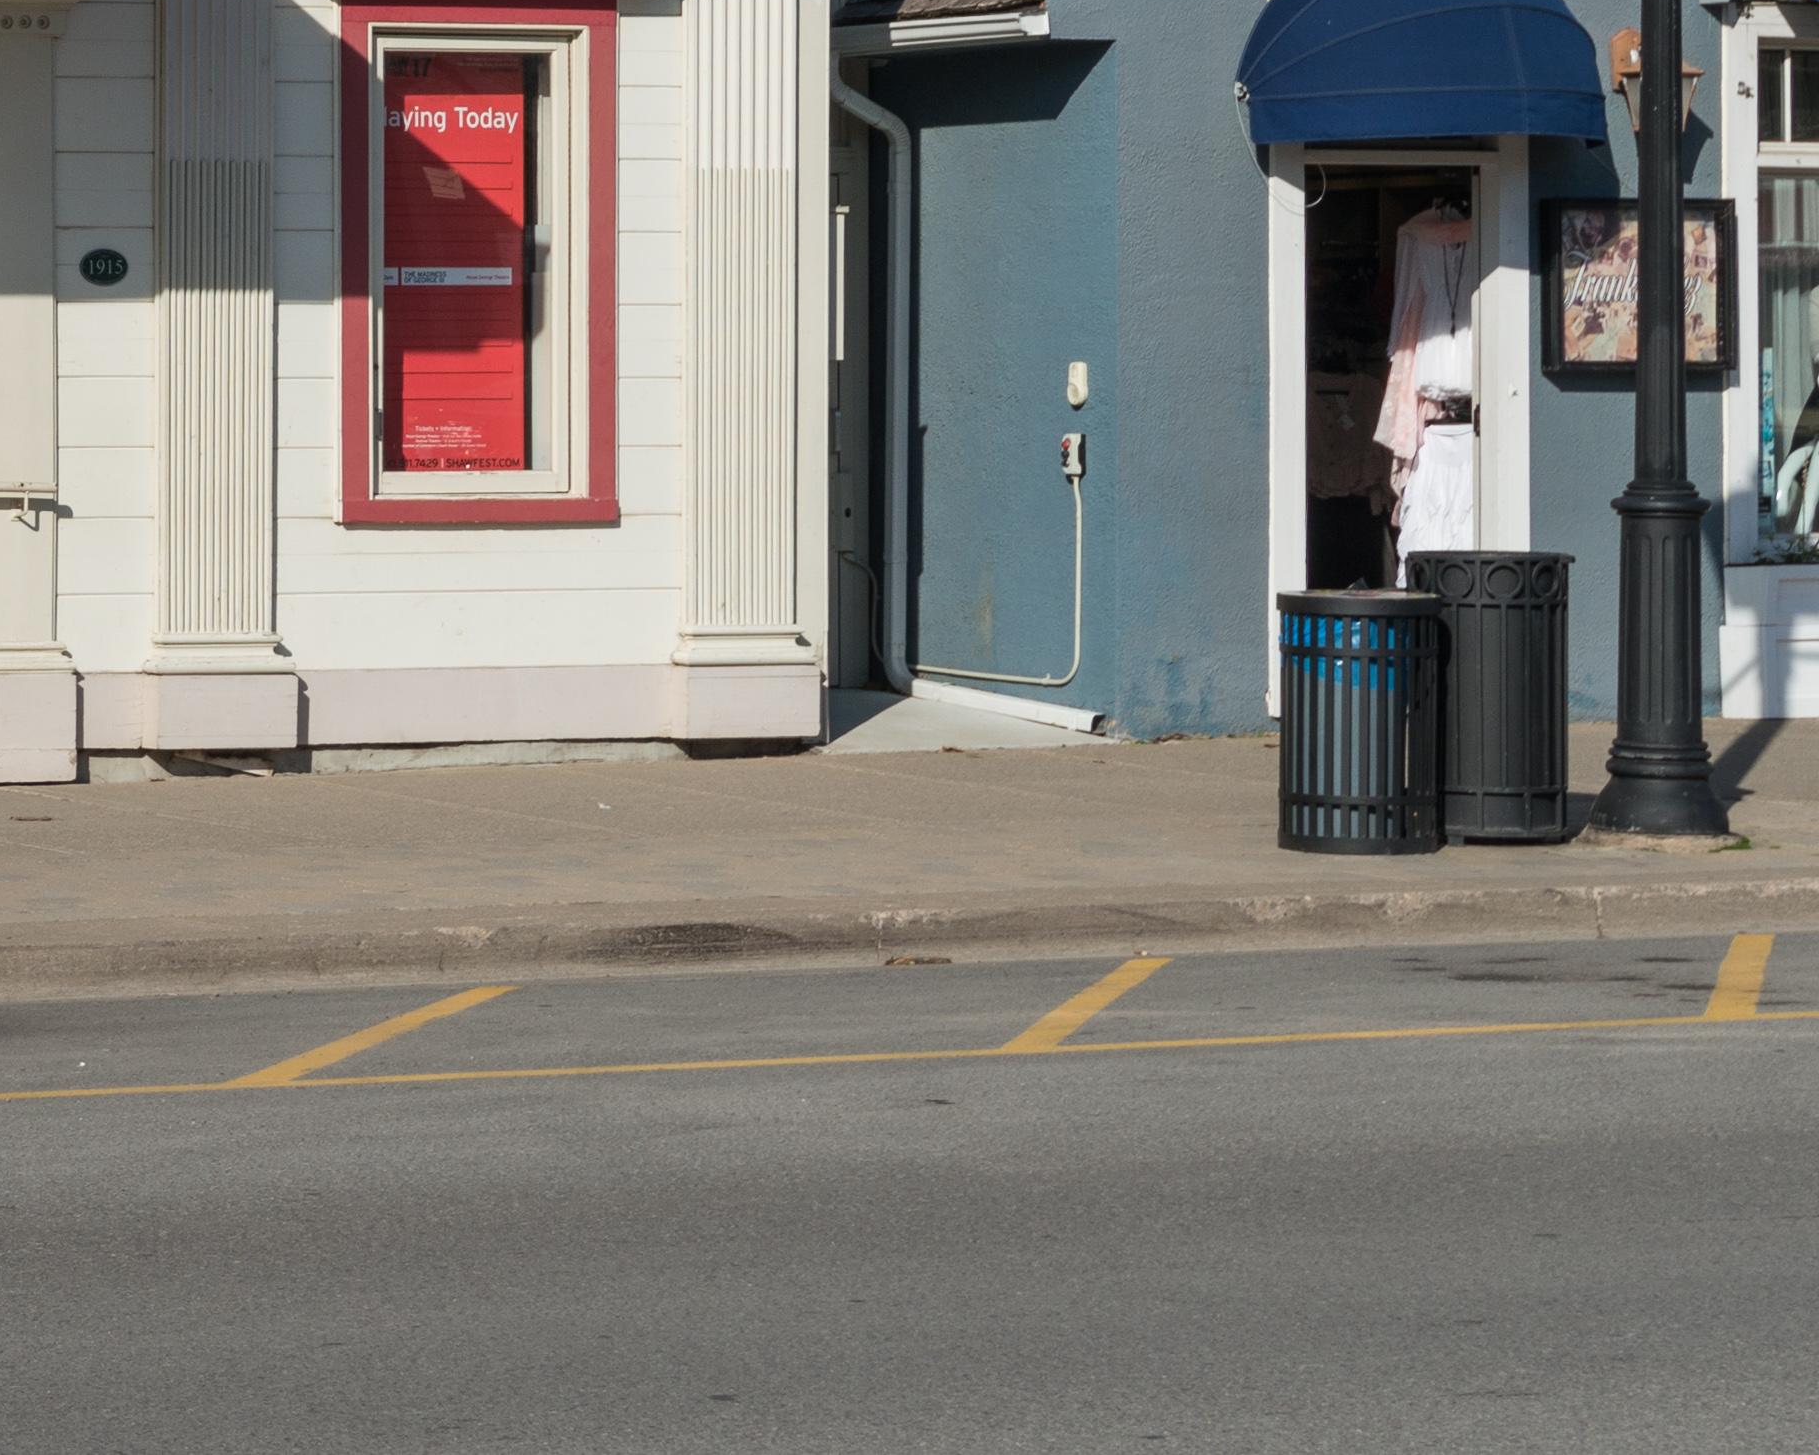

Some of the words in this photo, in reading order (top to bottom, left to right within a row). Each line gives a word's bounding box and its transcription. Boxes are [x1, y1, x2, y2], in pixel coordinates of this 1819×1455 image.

[383, 106, 446, 133] laying
[454, 106, 518, 134] Today
[90, 259, 124, 275] 1915
[446, 458, 520, 468] SHAWFEST.COM
